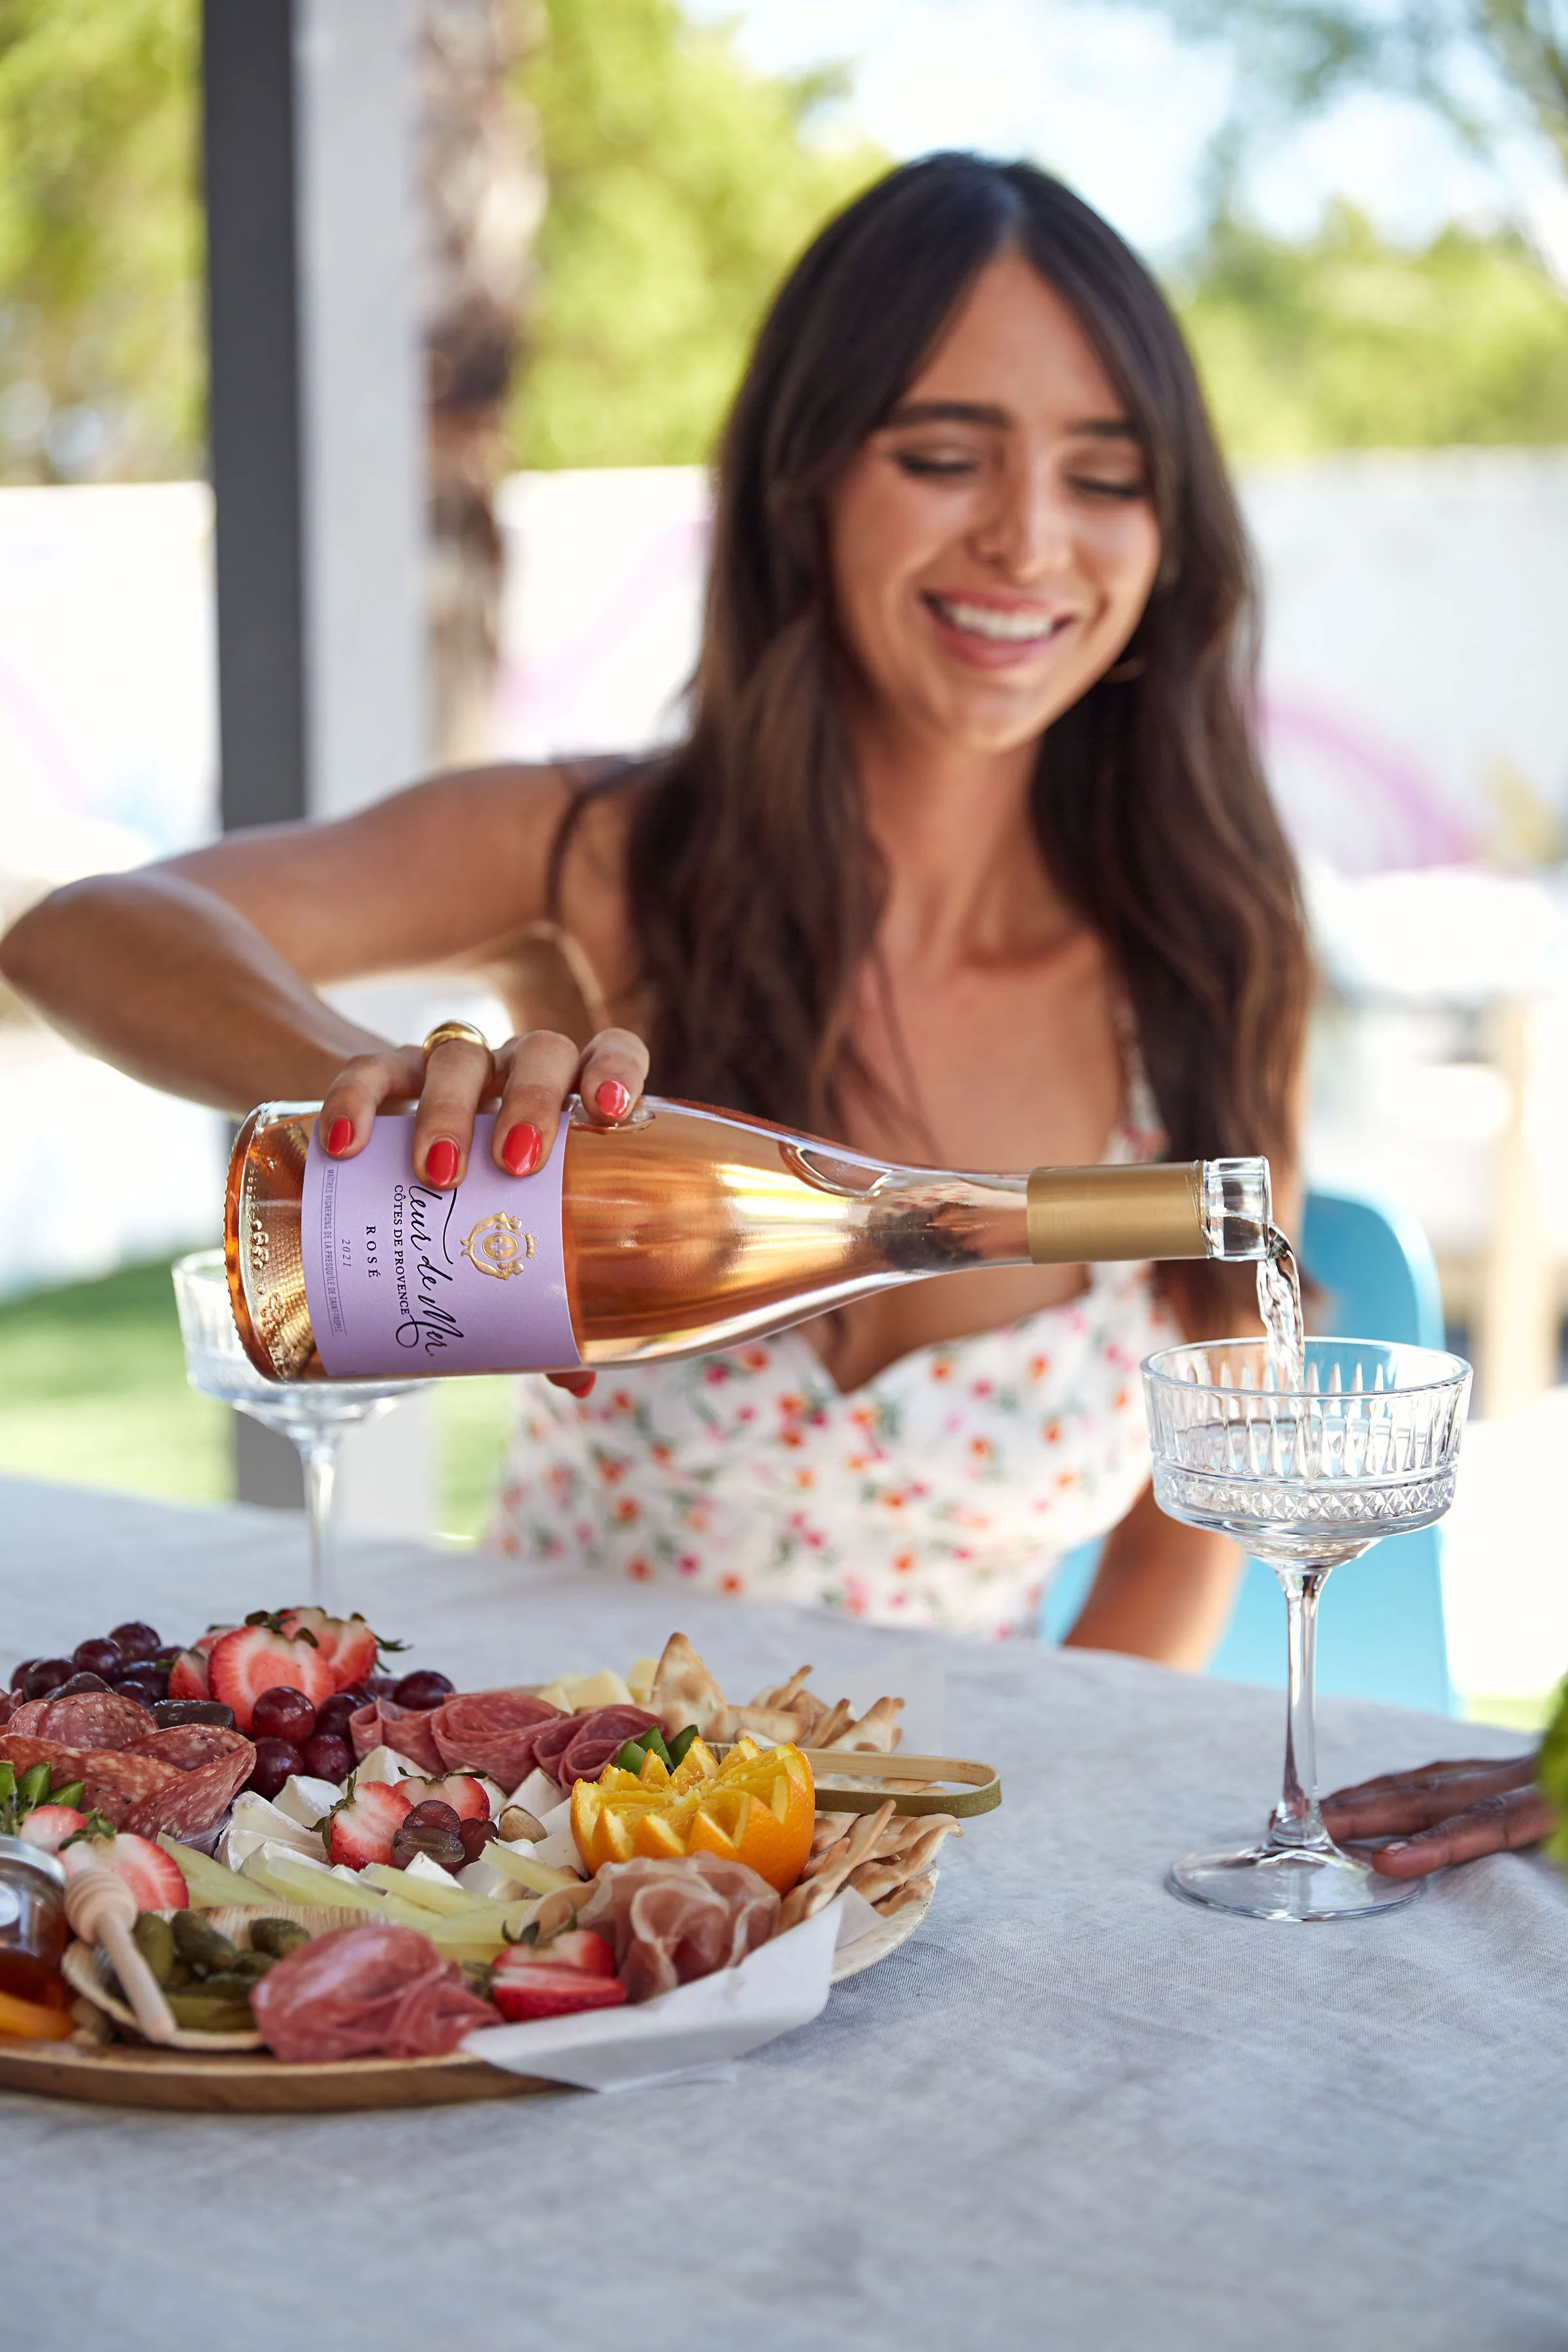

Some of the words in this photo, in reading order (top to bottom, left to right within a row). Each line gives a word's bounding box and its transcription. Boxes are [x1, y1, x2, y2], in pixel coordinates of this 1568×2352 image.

[324, 1194, 333, 1229] VIGNERONS
[393, 1184, 406, 1226] CÔTES
[324, 1231, 332, 1239] DE
[366, 1225, 381, 1278] ROSÉ
[393, 1229, 403, 1247] DE
[342, 1239, 351, 1267] 2021
[328, 1286, 336, 1295] DE
[395, 1250, 410, 1315] PROVENCE
[417, 1256, 453, 1291] de
[329, 1296, 343, 1333] SAINT-TROPEZ
[395, 1294, 465, 1356] Mer
